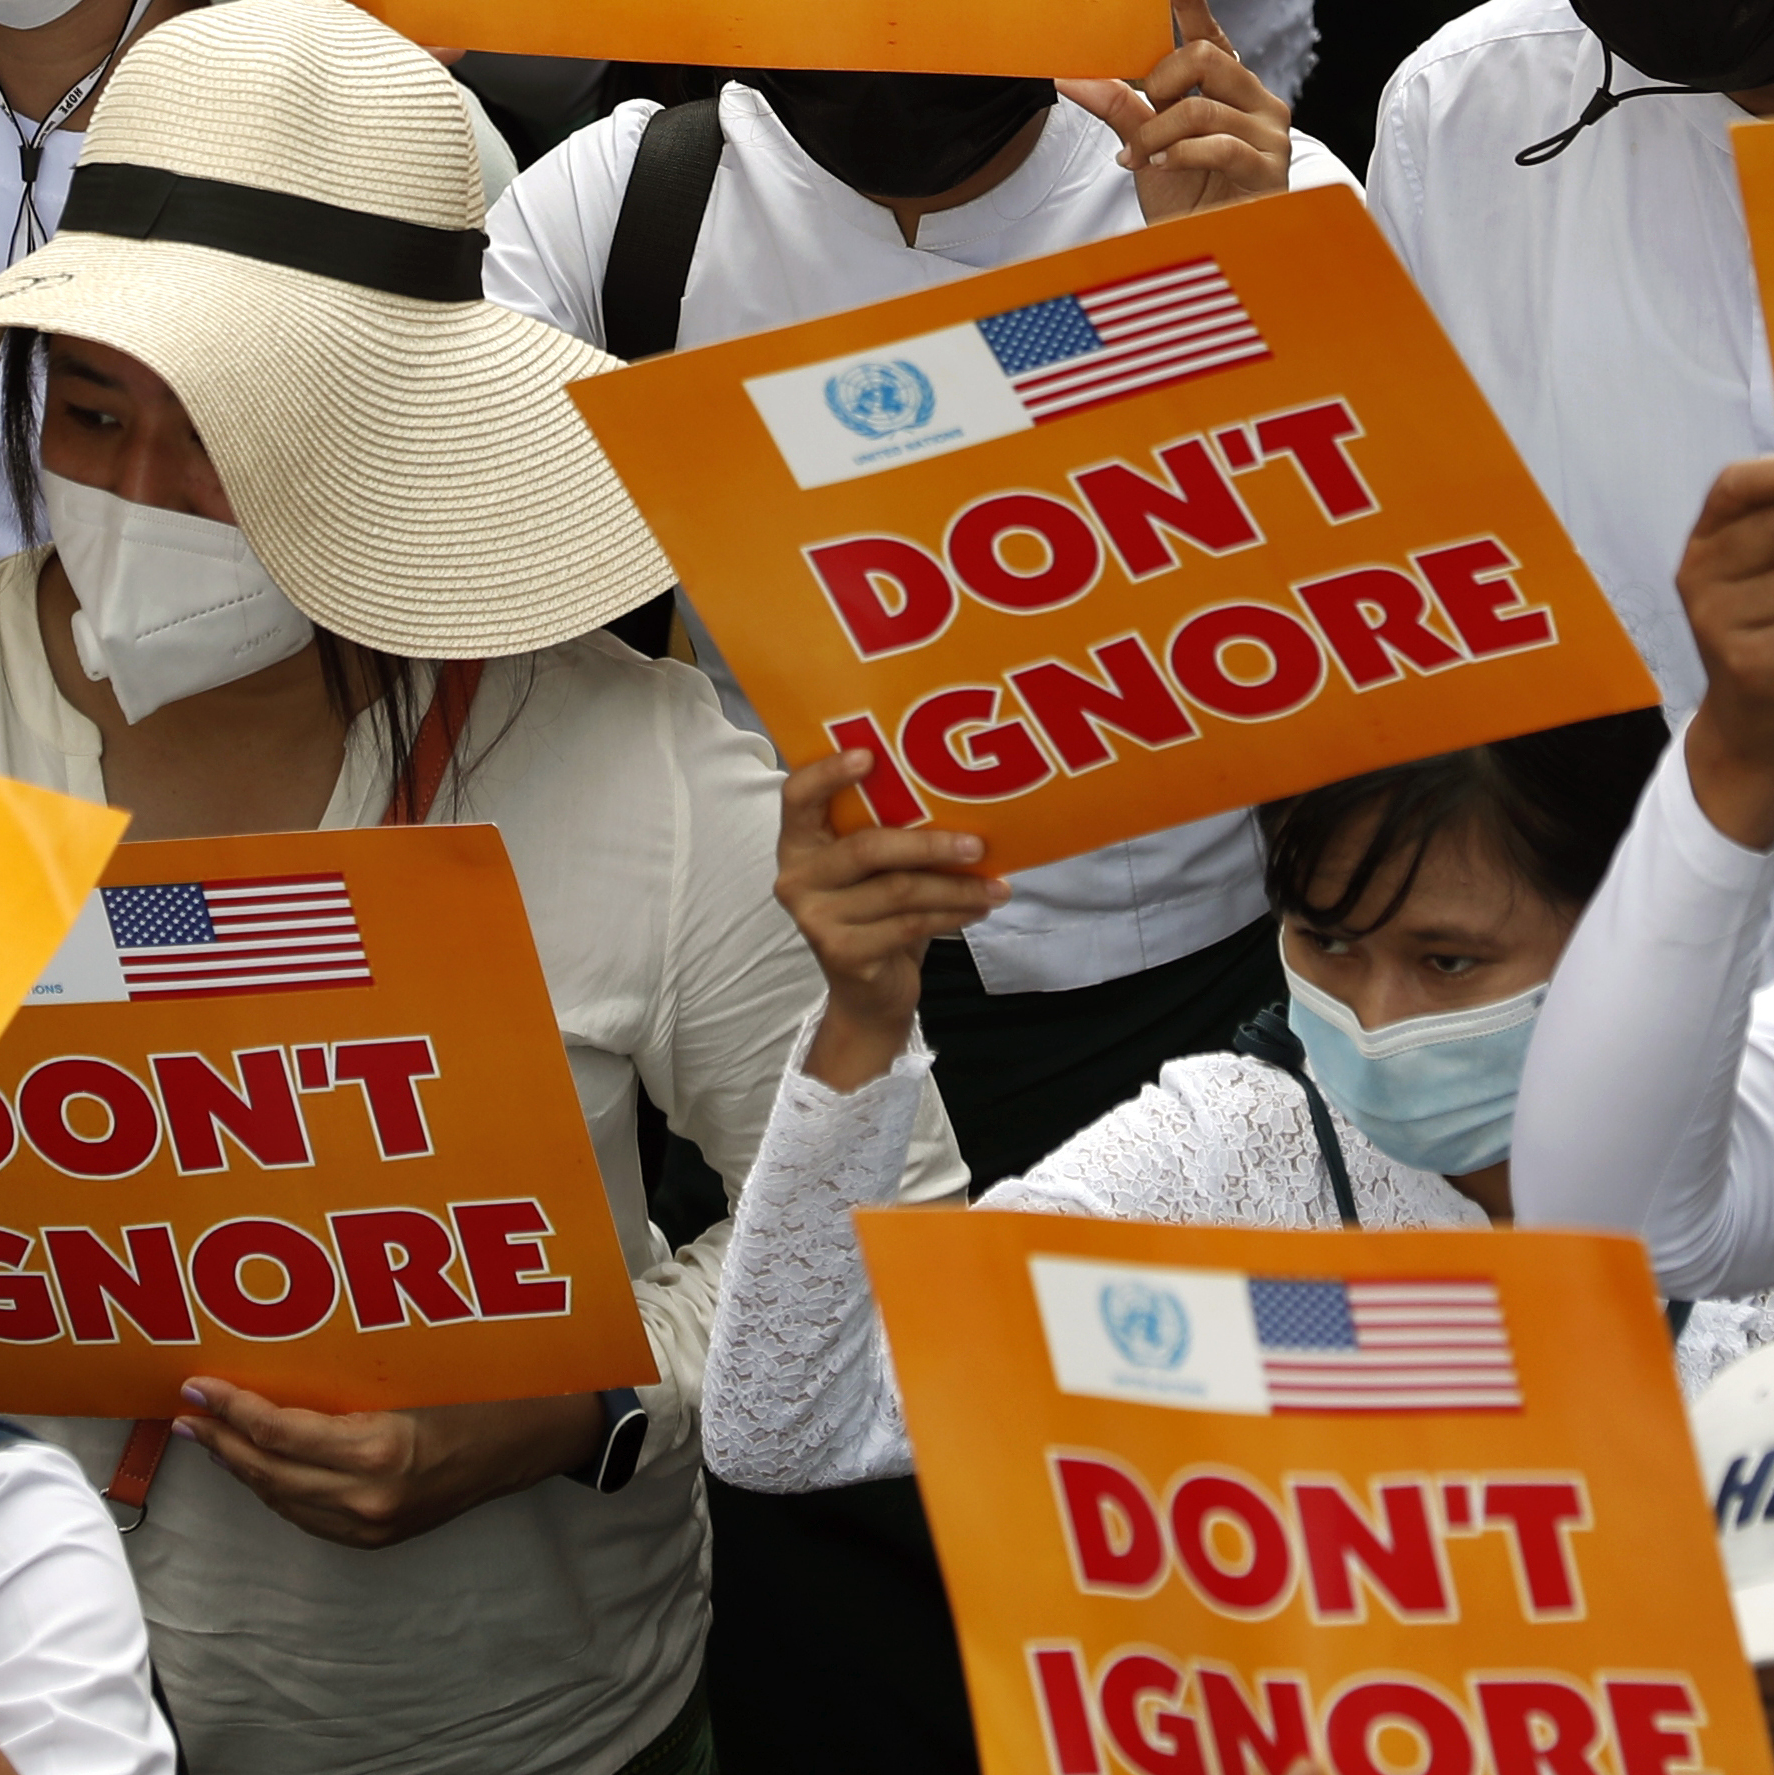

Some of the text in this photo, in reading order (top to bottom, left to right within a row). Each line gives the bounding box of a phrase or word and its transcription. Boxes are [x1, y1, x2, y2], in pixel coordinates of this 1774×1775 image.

[58, 87, 84, 115] HOPE
[802, 397, 1379, 663] DON'T
[824, 536, 1556, 830] IGNORE
[1047, 1446, 1595, 1624] DON'T
